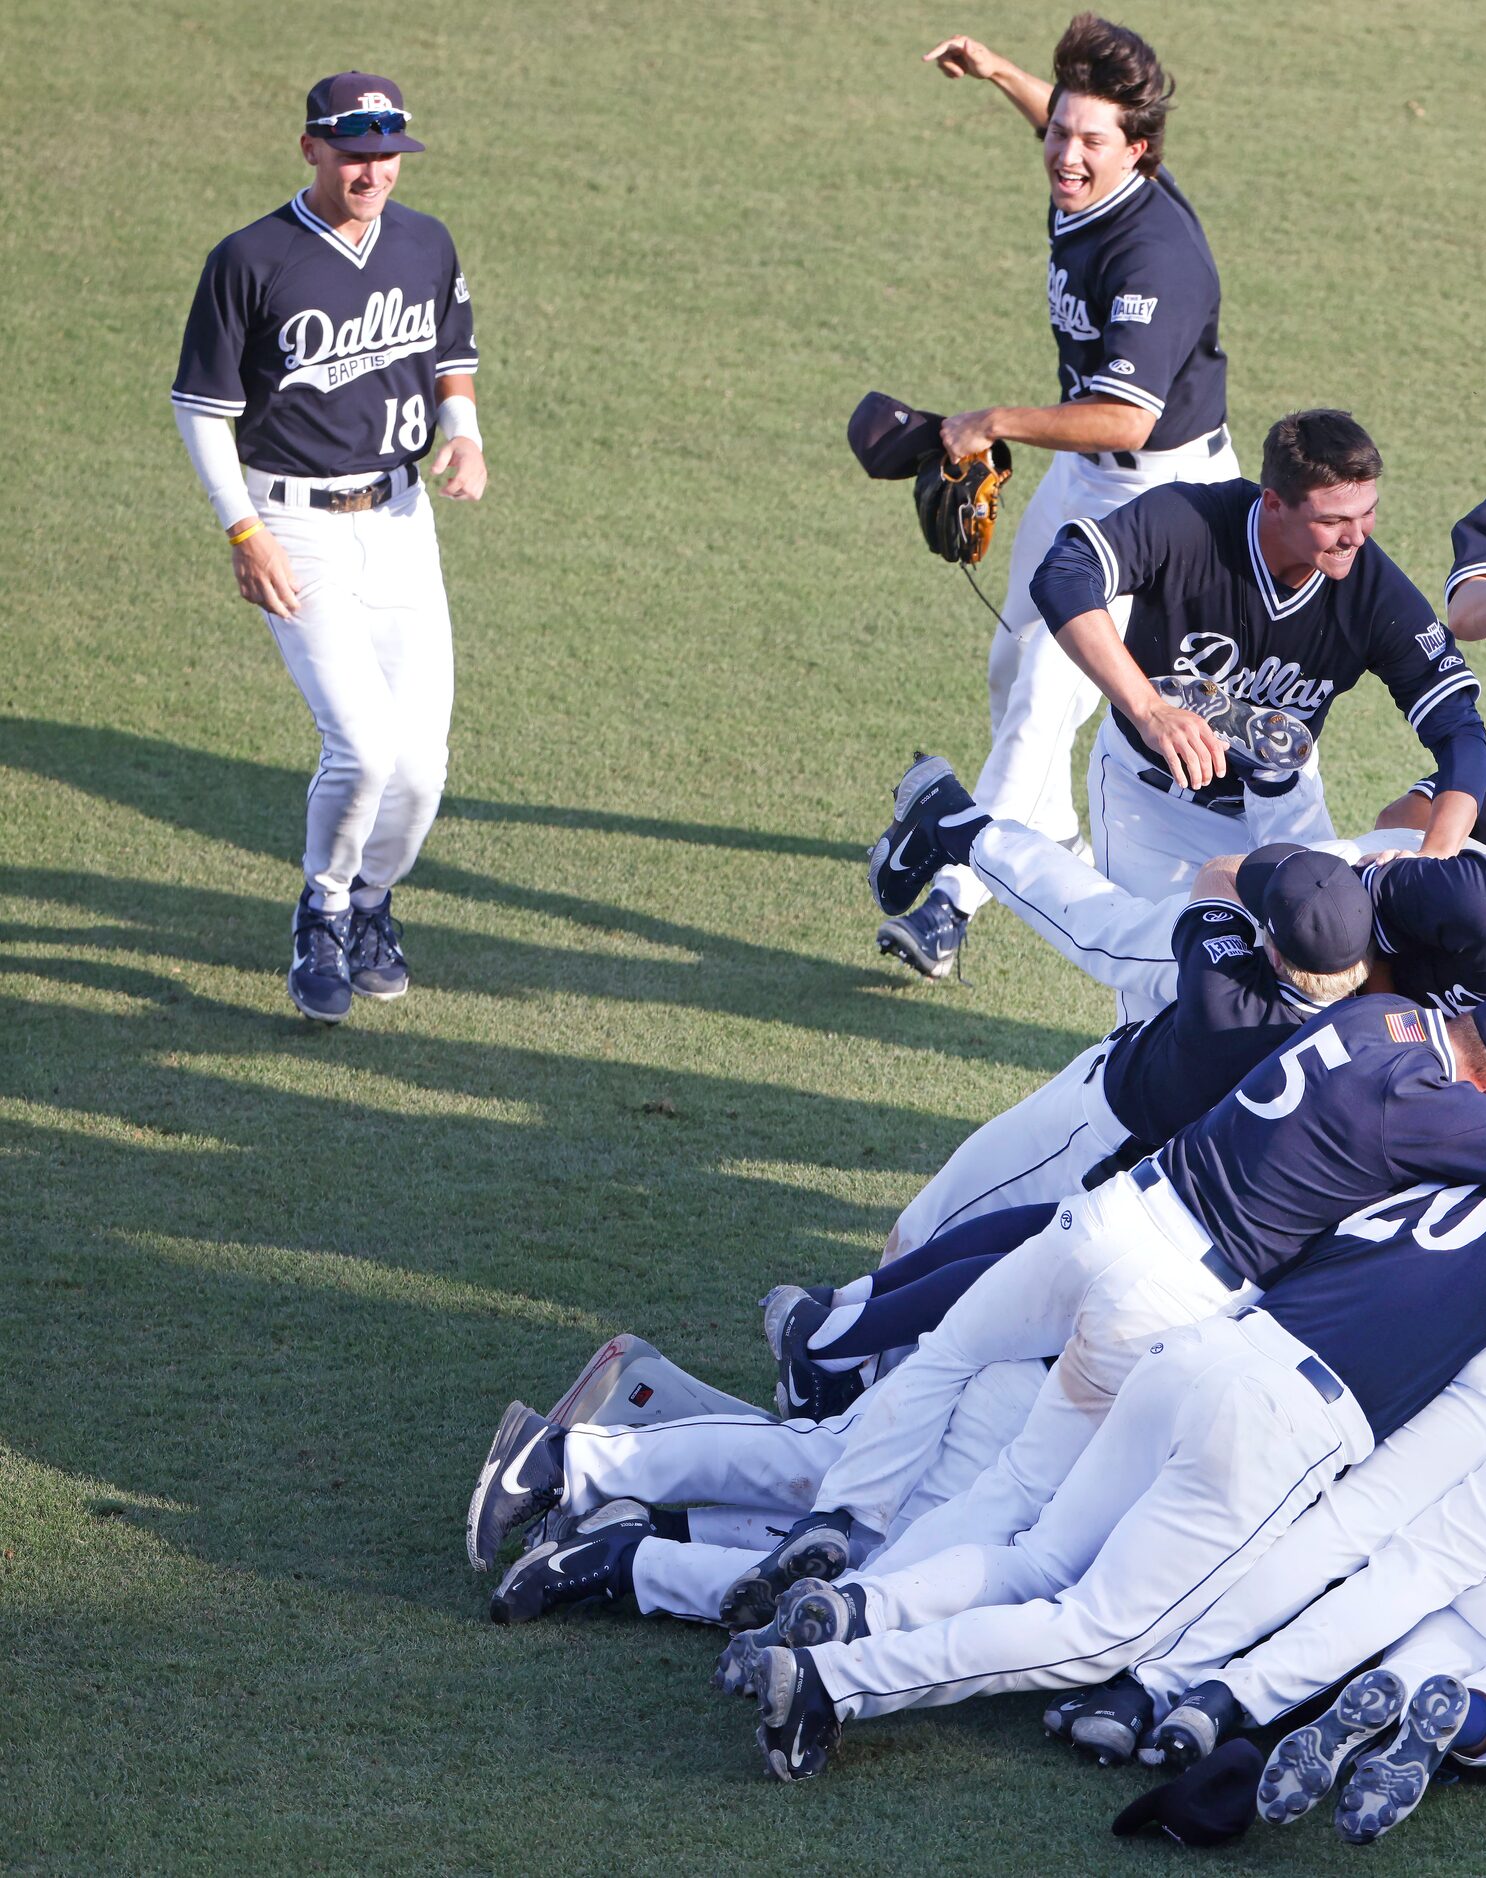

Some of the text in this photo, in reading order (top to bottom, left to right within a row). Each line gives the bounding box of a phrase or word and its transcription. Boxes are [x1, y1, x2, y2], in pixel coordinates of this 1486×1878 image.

[278, 287, 437, 370] Dallas
[379, 394, 428, 455] 18
[1173, 631, 1335, 708] Dallas
[1235, 1023, 1352, 1120] 5
